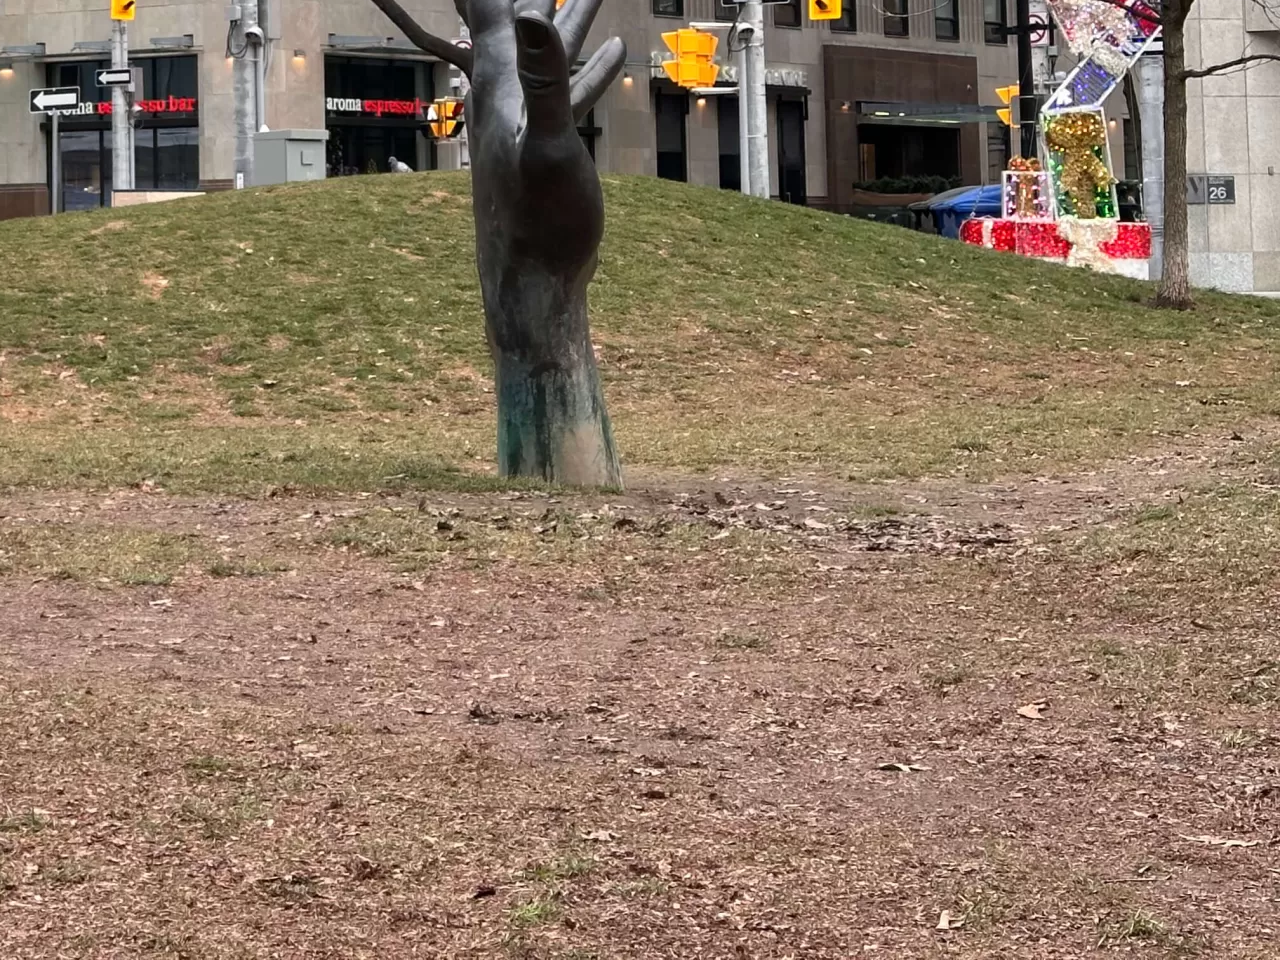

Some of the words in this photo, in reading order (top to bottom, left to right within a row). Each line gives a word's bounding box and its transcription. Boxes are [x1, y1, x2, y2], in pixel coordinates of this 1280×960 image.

[169, 95, 195, 112] bar
[326, 97, 362, 111] aroma
[364, 99, 414, 117] espresso
[1209, 186, 1227, 199] 26
